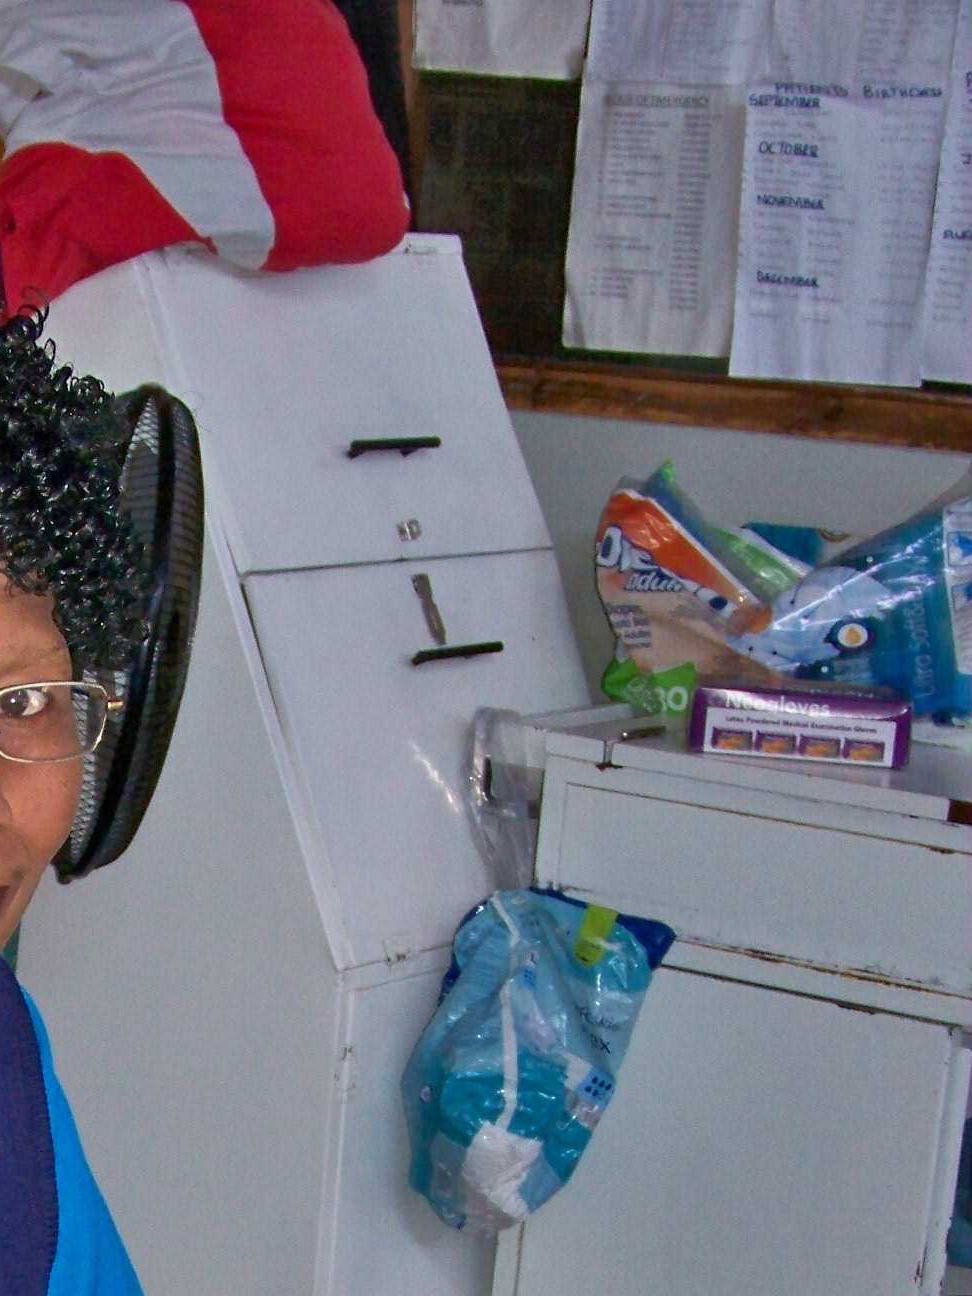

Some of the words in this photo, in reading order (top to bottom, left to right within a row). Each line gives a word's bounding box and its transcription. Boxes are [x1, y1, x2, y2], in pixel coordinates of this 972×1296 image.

[749, 94, 821, 108] SEPTEMBER
[758, 141, 818, 158] OCTOBER
[757, 194, 824, 210] NOVEMBER
[757, 270, 820, 288] DECEMBER
[782, 720, 810, 729] Medical
